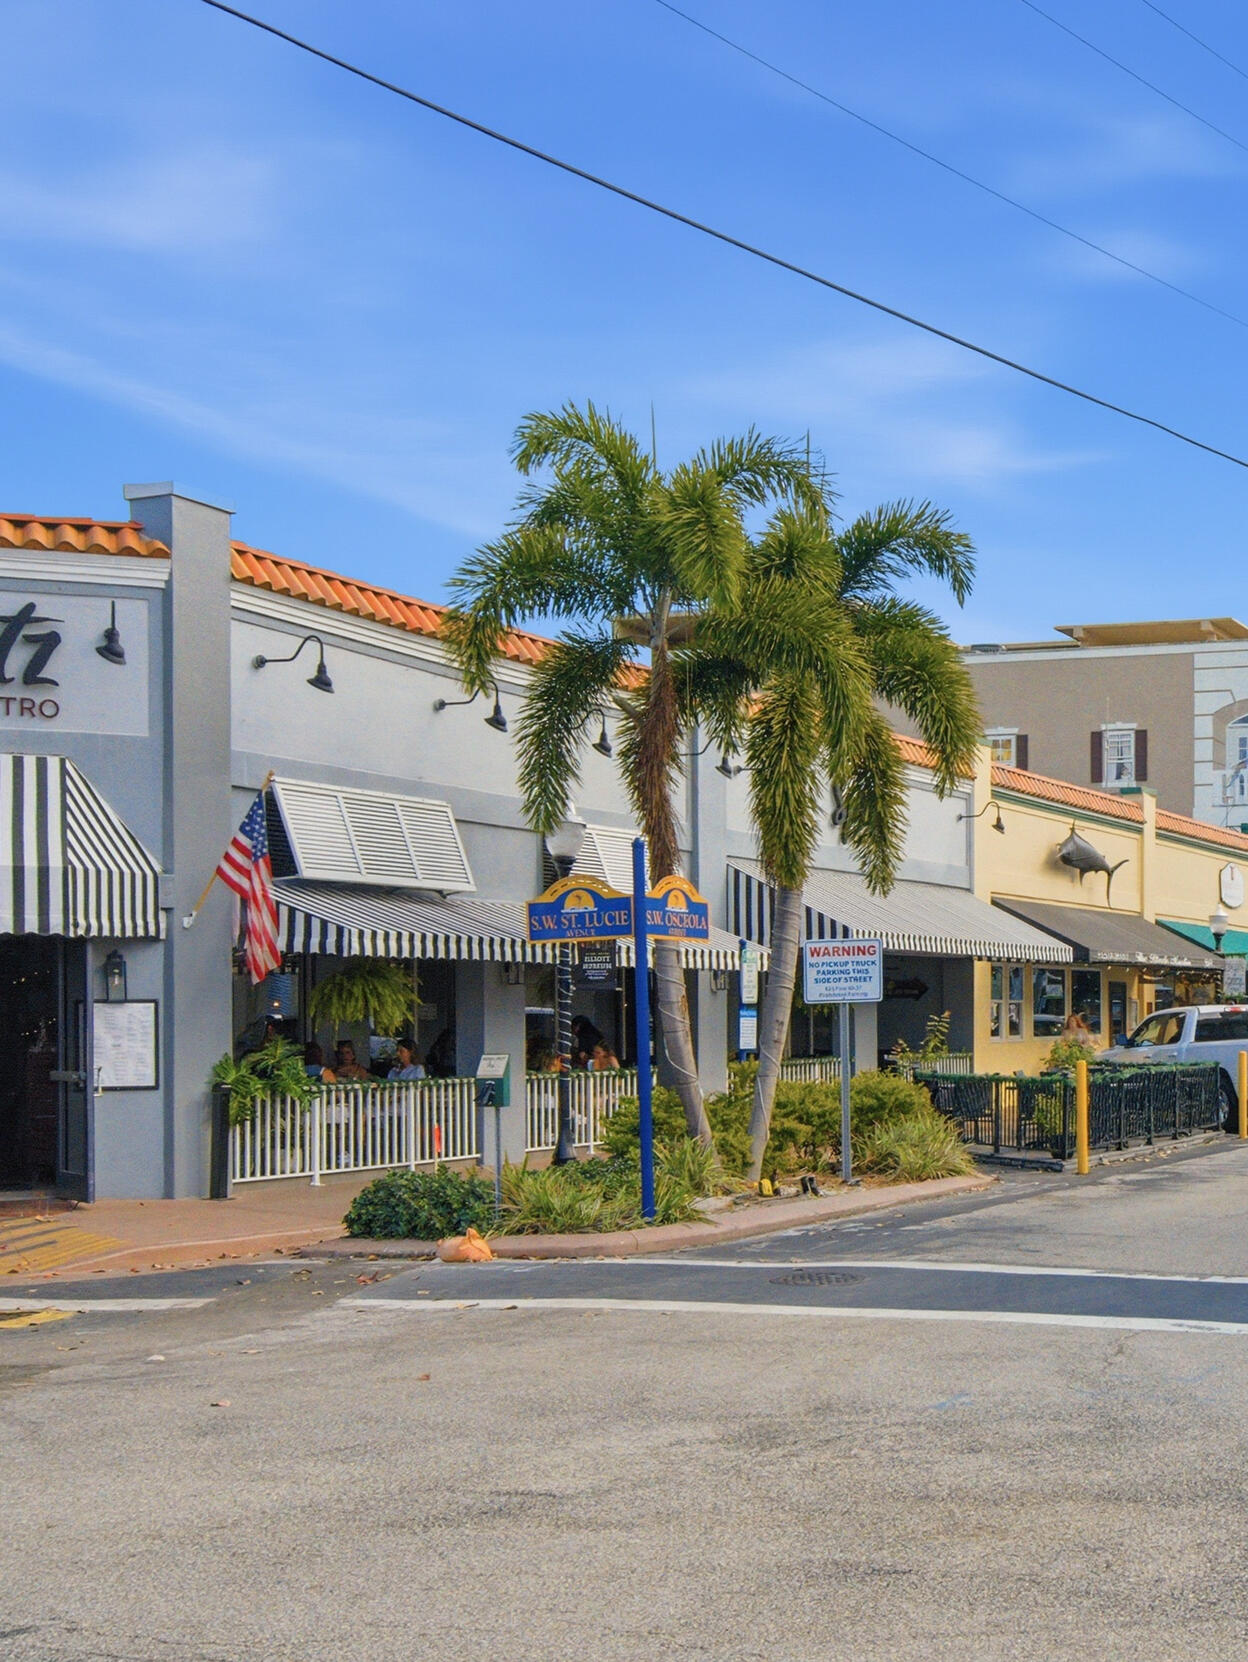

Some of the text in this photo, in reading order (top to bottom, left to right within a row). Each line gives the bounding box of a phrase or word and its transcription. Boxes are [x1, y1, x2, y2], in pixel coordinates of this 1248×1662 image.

[531, 910, 630, 930] S.W. ST. LUCIE
[646, 910, 707, 929] S.W. OSCEOLA
[809, 944, 877, 957] WARNING
[851, 959, 877, 967] TRUCK
[816, 968, 851, 976] PARKING
[832, 976, 842, 984] OF
[843, 975, 873, 983] STREET
